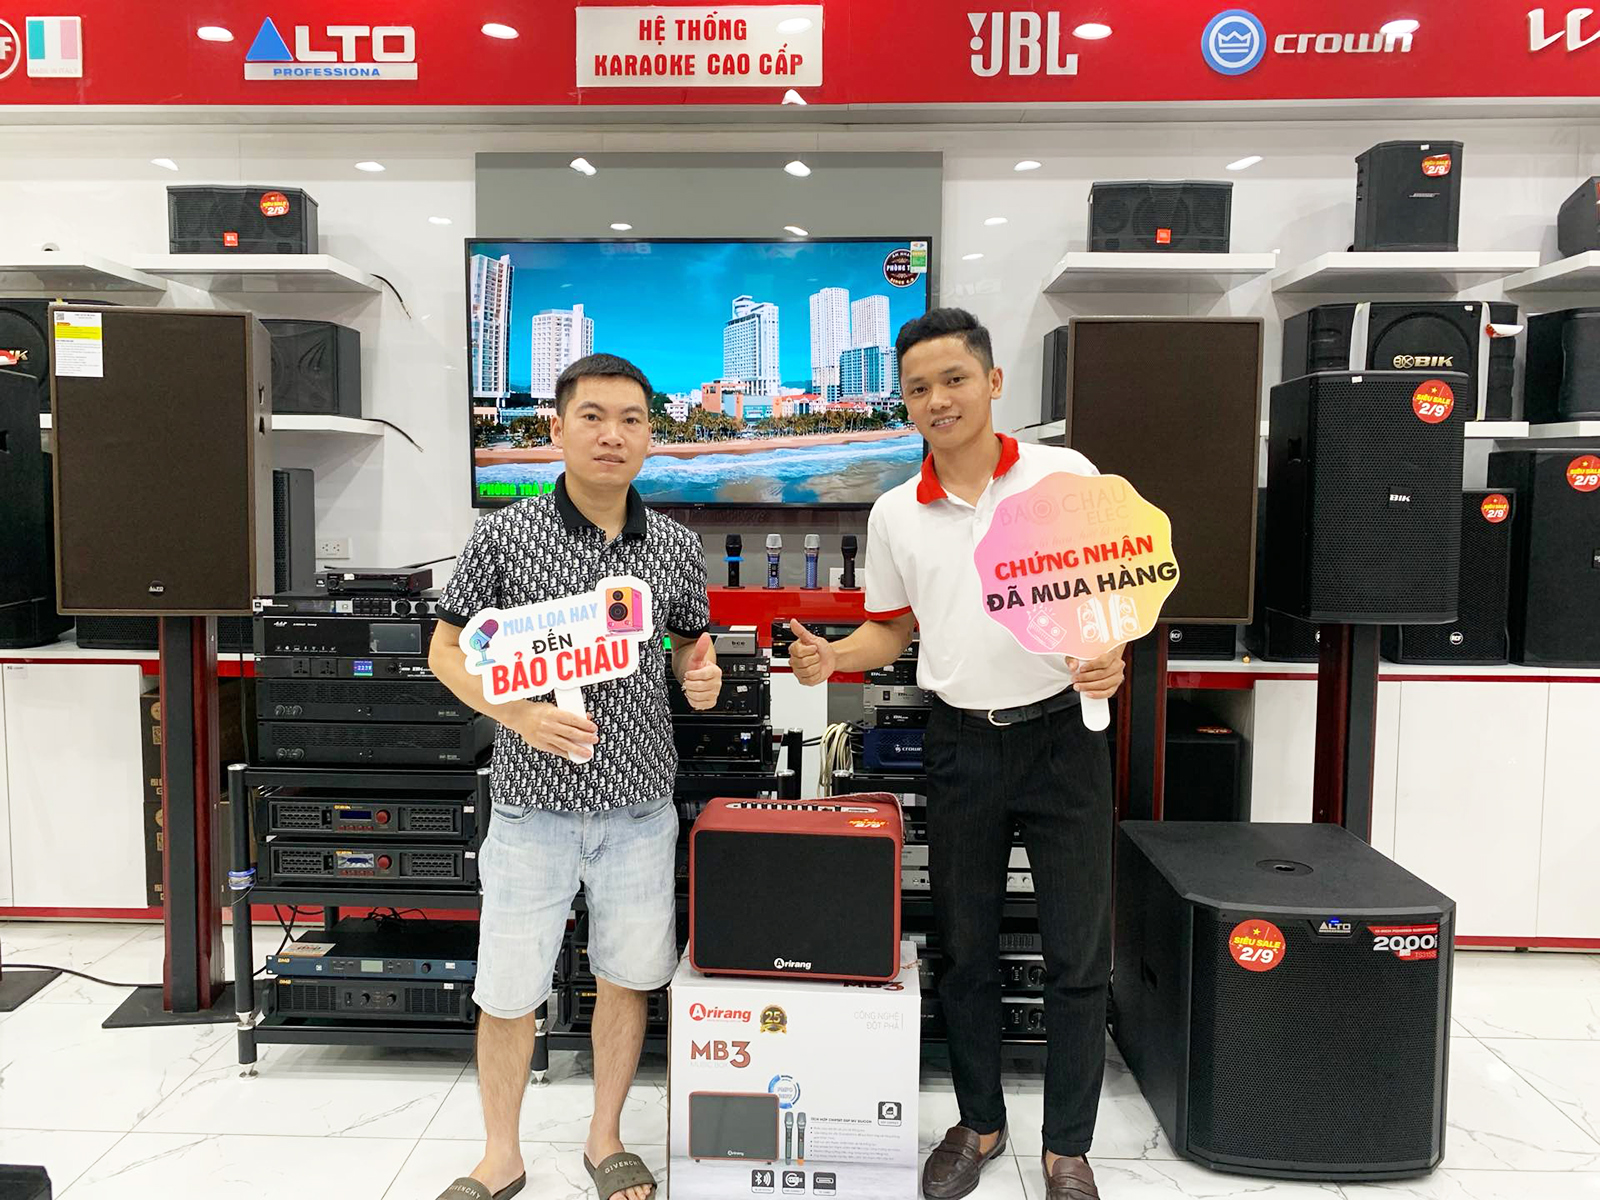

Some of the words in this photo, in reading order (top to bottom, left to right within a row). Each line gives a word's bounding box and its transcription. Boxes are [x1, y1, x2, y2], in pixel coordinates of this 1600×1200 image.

[639, 15, 665, 46] HỆ
[675, 10, 747, 41] THỐNG
[968, 11, 1078, 77] JBL
[1274, 31, 1414, 54] crown
[594, 54, 696, 77] KARAOKE
[707, 53, 751, 75] CAO
[759, 43, 804, 76] CẤP
[273, 67, 381, 77] PROFESSIONA
[1414, 356, 1454, 367] BIK
[1416, 393, 1432, 403] SIÊU
[1433, 396, 1452, 405] SALE
[1419, 404, 1445, 417] 2/9
[1574, 475, 1598, 486] 2/9
[1389, 494, 1411, 502] BIK
[1487, 510, 1504, 518] 2/9
[994, 551, 1079, 581] CHỨNG
[1083, 534, 1154, 566] NHẬN
[986, 586, 1025, 613] ĐÃ
[1031, 578, 1092, 605] MUA
[1097, 561, 1177, 593] HÀNG
[503, 616, 532, 637] MUA
[538, 608, 567, 629] LOA
[570, 602, 599, 623] HAY
[531, 628, 574, 655] ĐẾN
[492, 651, 548, 696] BẢO
[556, 635, 630, 682] CHÂU
[1319, 921, 1351, 930] ALTO
[1233, 936, 1256, 945] SIÊU
[1256, 939, 1281, 949] SALE
[1373, 935, 1434, 951] 2000
[1239, 946, 1274, 963] 2/9
[774, 957, 812, 970] Arirang
[689, 1003, 752, 1022] Arirang
[765, 1011, 781, 1023] 25
[691, 1040, 751, 1068] MB3
